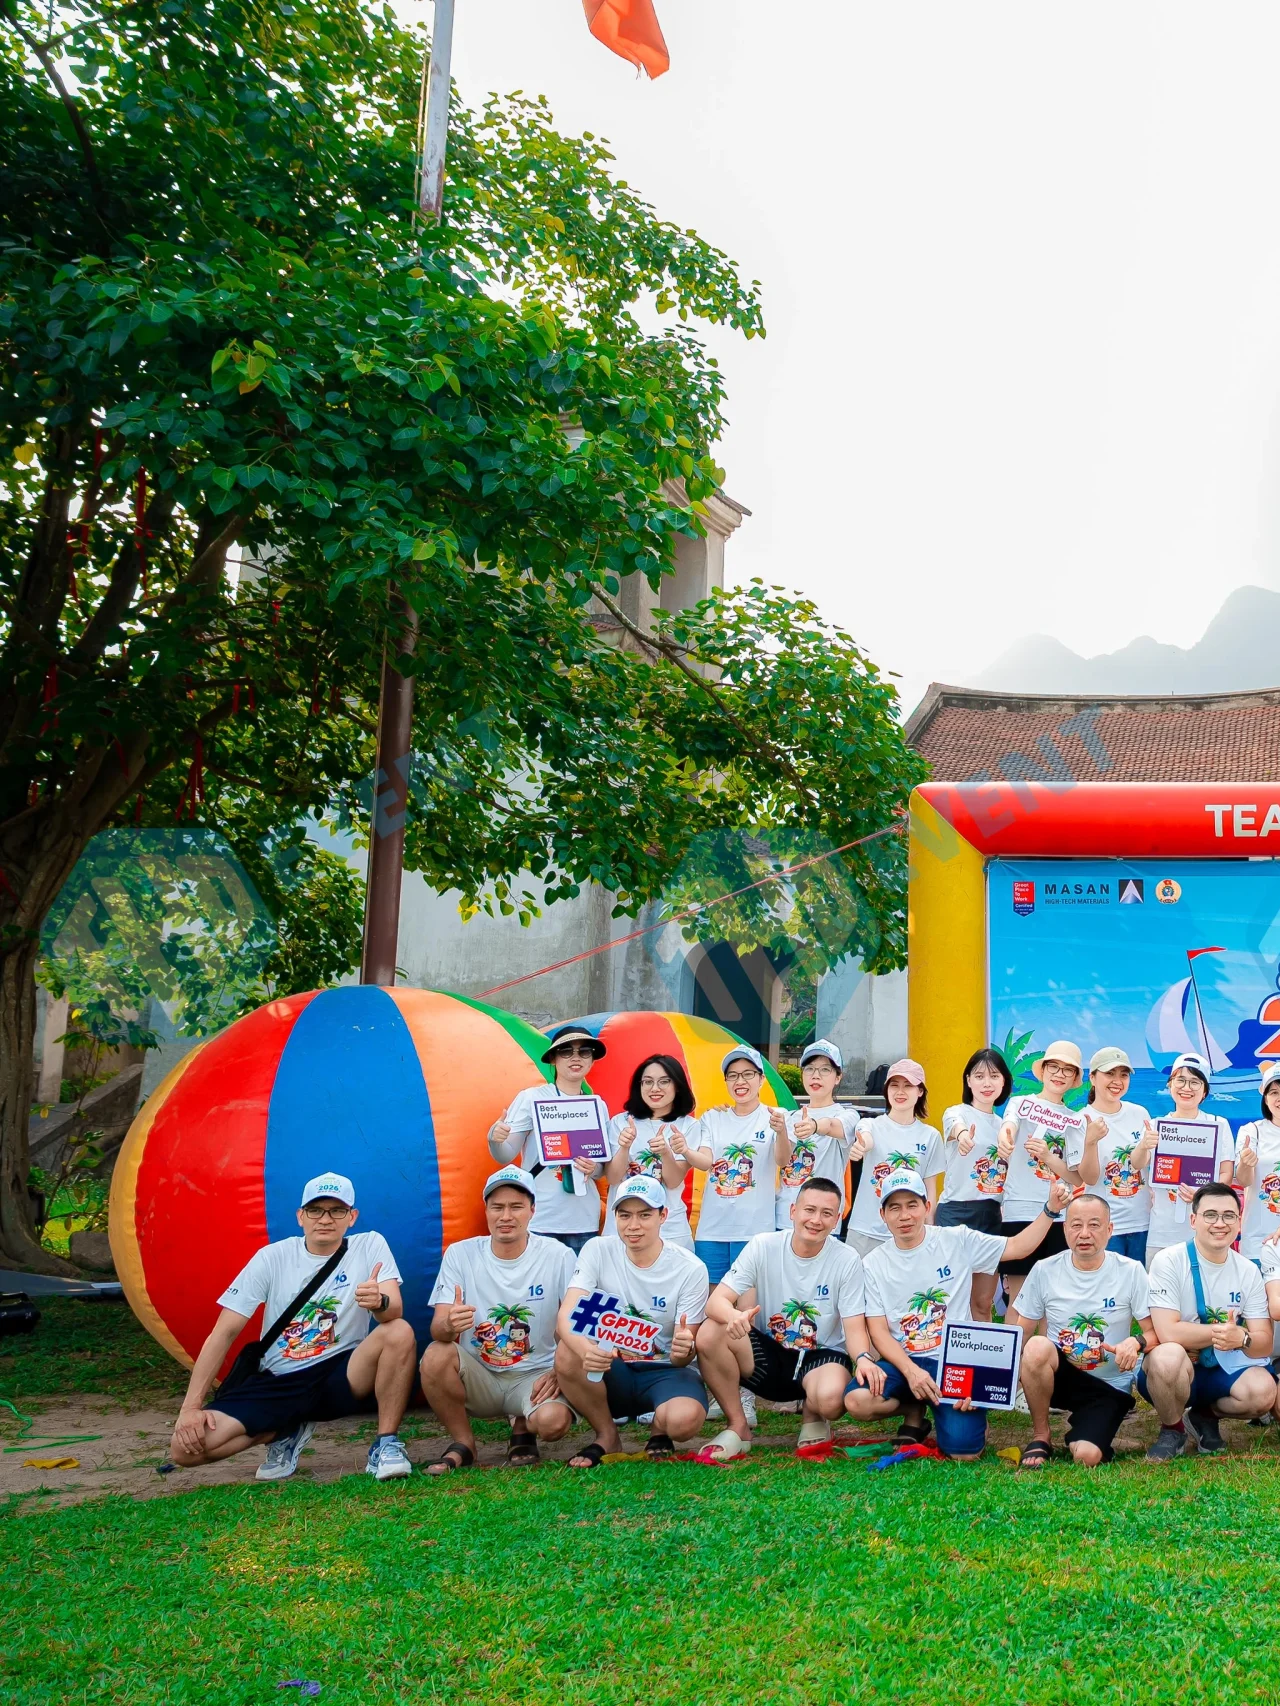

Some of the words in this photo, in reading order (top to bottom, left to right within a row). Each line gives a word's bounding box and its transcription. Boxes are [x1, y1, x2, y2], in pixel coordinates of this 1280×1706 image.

[1044, 883, 1110, 895] MASAN
[1034, 1104, 1062, 1120] Culture
[1062, 1116, 1081, 1126] goal
[1029, 1114, 1065, 1131] unlocked
[755, 1131, 765, 1139] 16
[916, 1143, 927, 1151] 16
[891, 1177, 909, 1186] 2026
[937, 1265, 951, 1278] 16
[334, 1271, 347, 1284] 16
[528, 1285, 544, 1296] 16
[817, 1285, 829, 1296] 16
[652, 1296, 666, 1307] 16
[1102, 1297, 1115, 1308] 16
[1229, 1292, 1241, 1302] 16
[597, 1327, 650, 1353] VN2026
[951, 1330, 971, 1340] Best
[945, 1374, 964, 1382] Place
[944, 1386, 962, 1394] Work
[984, 1385, 1008, 1393] VIETNAM
[989, 1393, 1007, 1401] 2026
